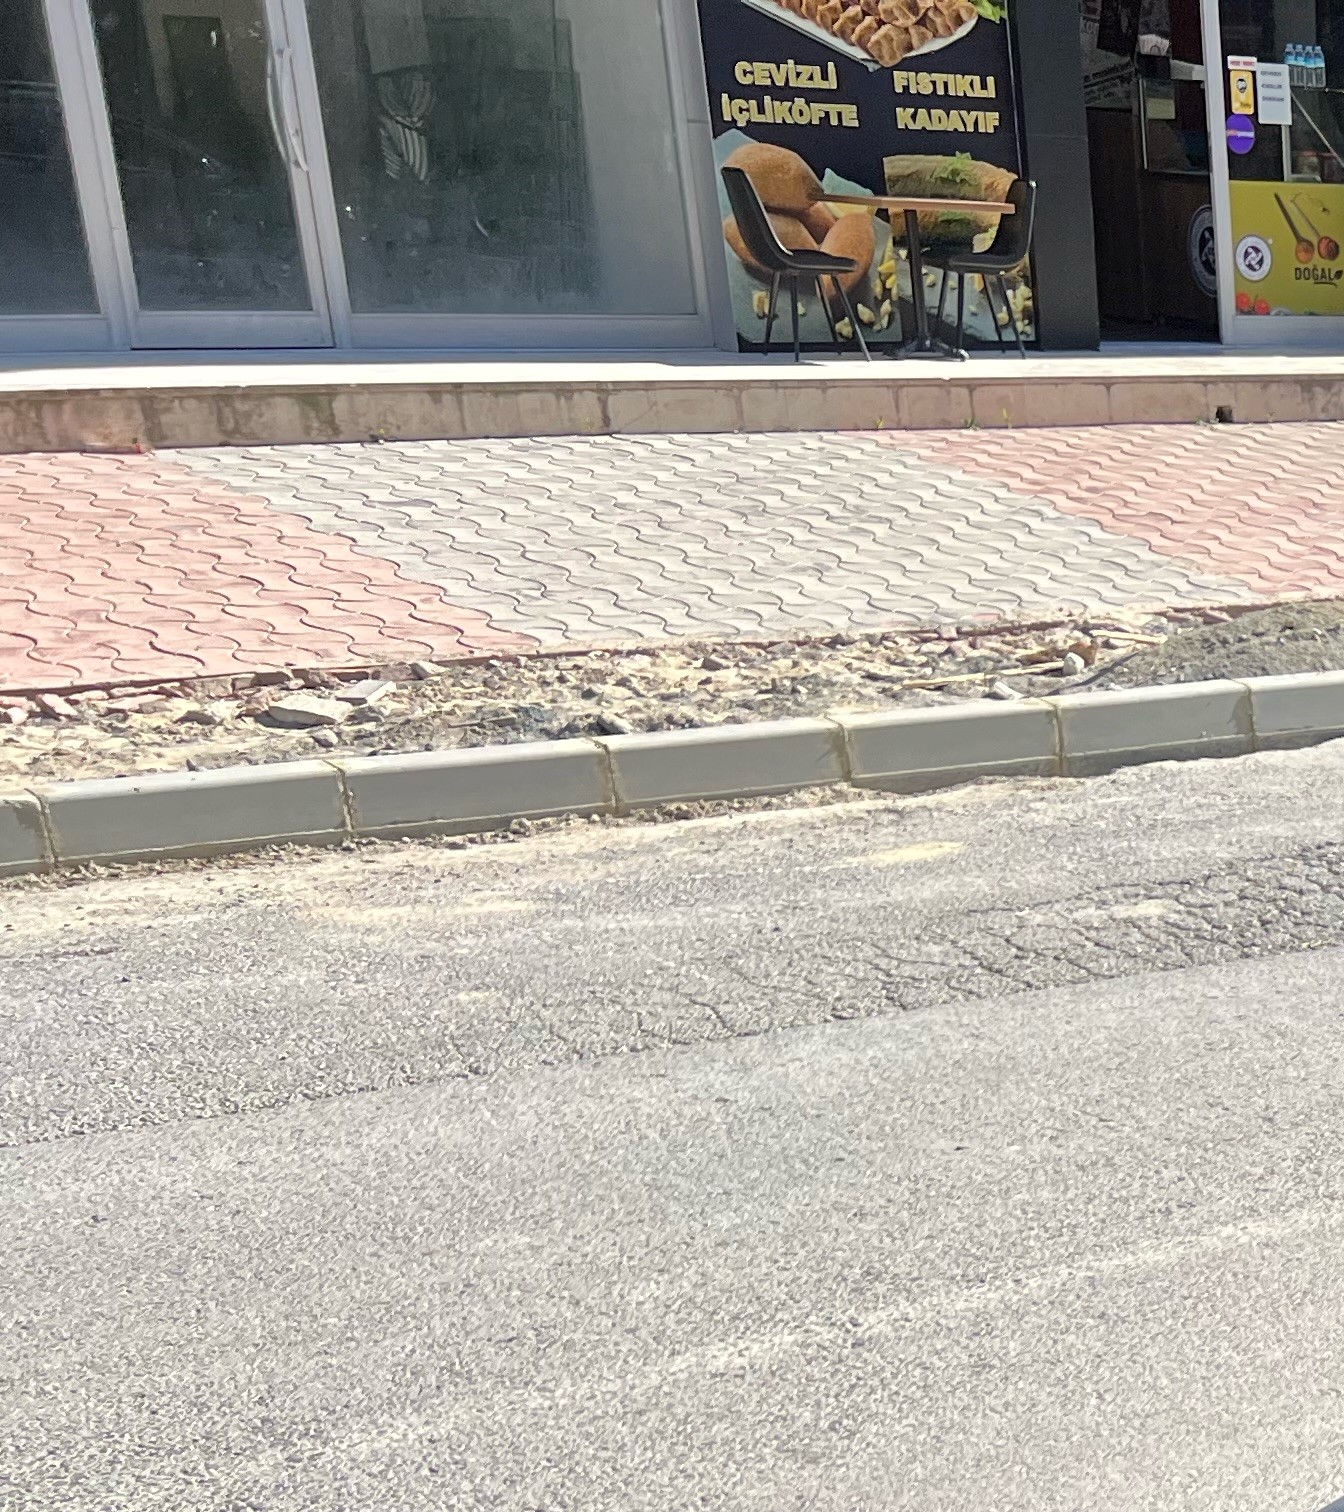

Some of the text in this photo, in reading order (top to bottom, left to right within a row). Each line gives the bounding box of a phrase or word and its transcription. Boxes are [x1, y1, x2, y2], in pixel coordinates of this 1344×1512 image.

[734, 59, 838, 90] CEVİZLİ
[893, 70, 997, 99] FISTIKLI
[721, 93, 860, 128] İÇLİKÖFTE
[896, 107, 1000, 133] KADAYIF
[1294, 264, 1334, 281] DOĞAL
